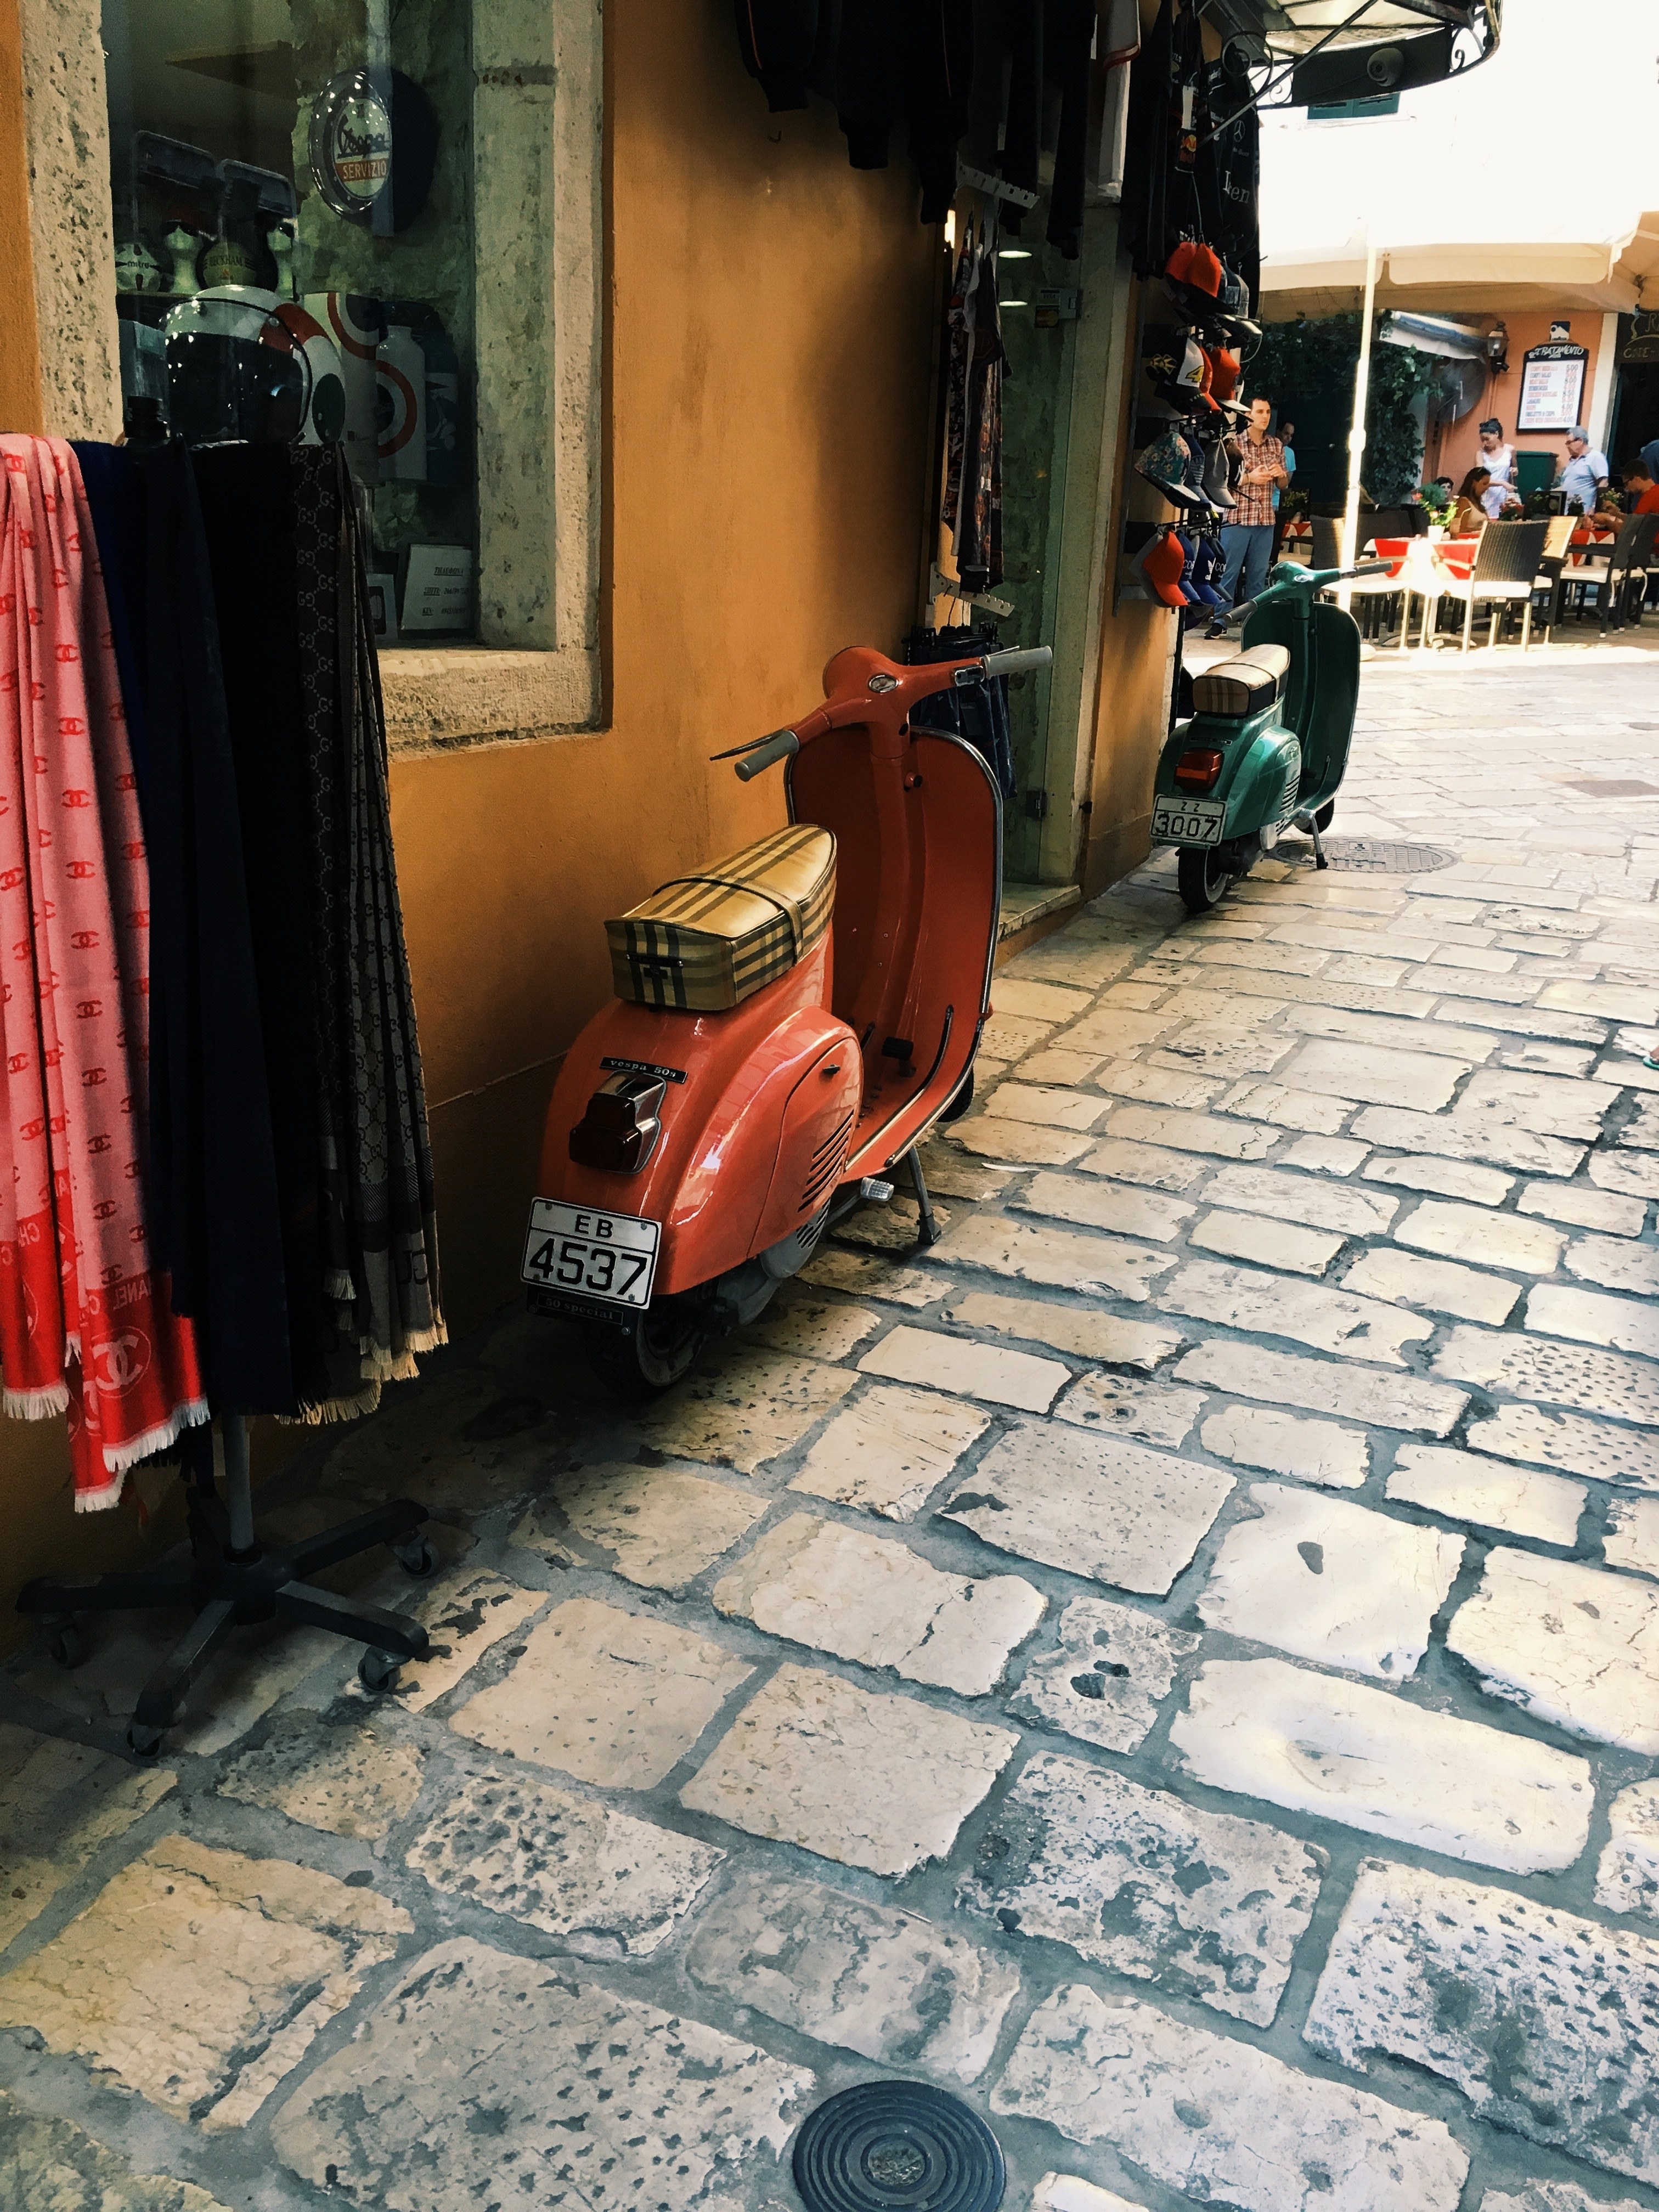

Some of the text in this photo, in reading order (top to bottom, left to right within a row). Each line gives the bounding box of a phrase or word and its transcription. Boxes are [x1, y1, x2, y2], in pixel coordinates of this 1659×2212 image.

[342, 161, 387, 179] SERVIZIO
[208, 255, 245, 267] BECKHAM
[1155, 811, 1218, 838] 3007
[610, 1059, 677, 1078] vespa 50s
[574, 1213, 614, 1239] EB
[529, 1237, 648, 1297] 4537
[545, 1297, 562, 1308] 50
